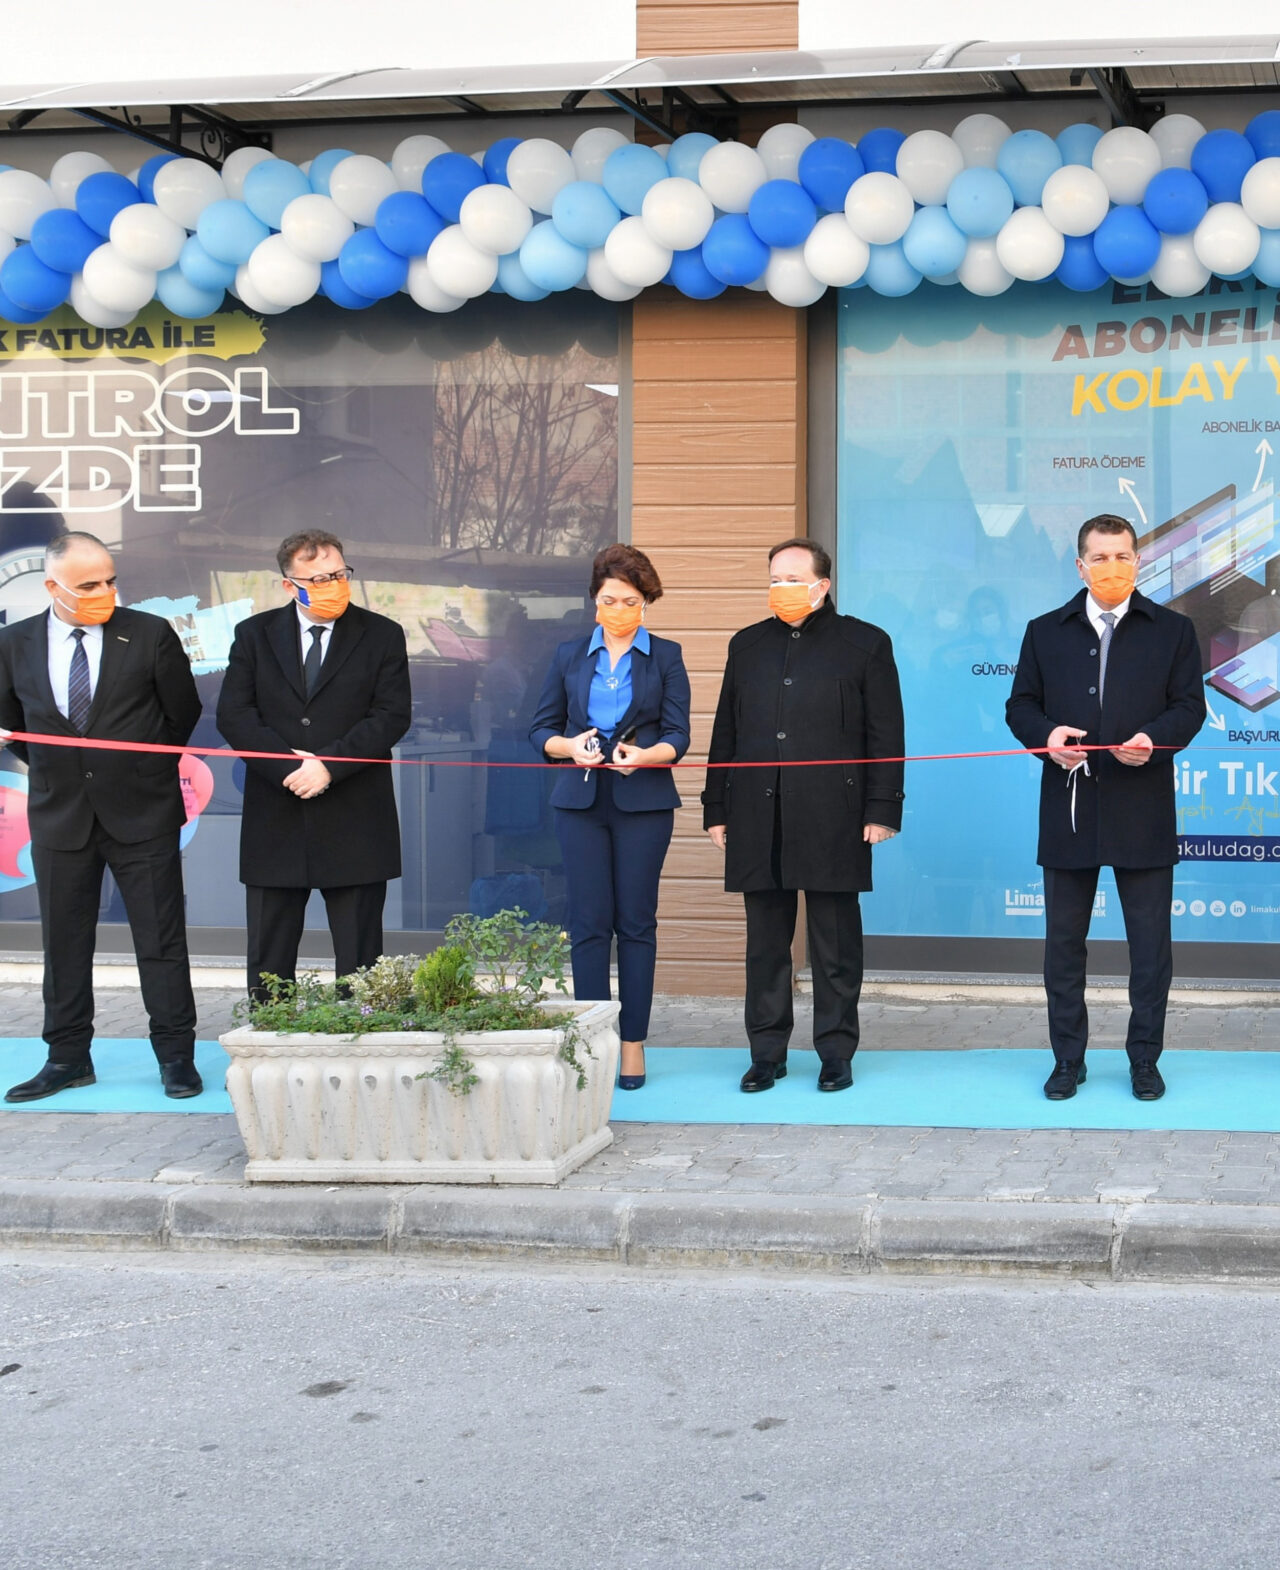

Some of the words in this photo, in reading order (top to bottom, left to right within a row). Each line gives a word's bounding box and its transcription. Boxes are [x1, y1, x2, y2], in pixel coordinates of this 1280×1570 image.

[16, 327, 156, 351] FATURA
[162, 320, 216, 348] İLE
[1071, 357, 1249, 416] KOLAY
[1202, 418, 1263, 433] ABONELİK
[1053, 457, 1099, 469] FATURA
[1101, 454, 1145, 468] ÖDEME
[1174, 760, 1208, 796] ir
